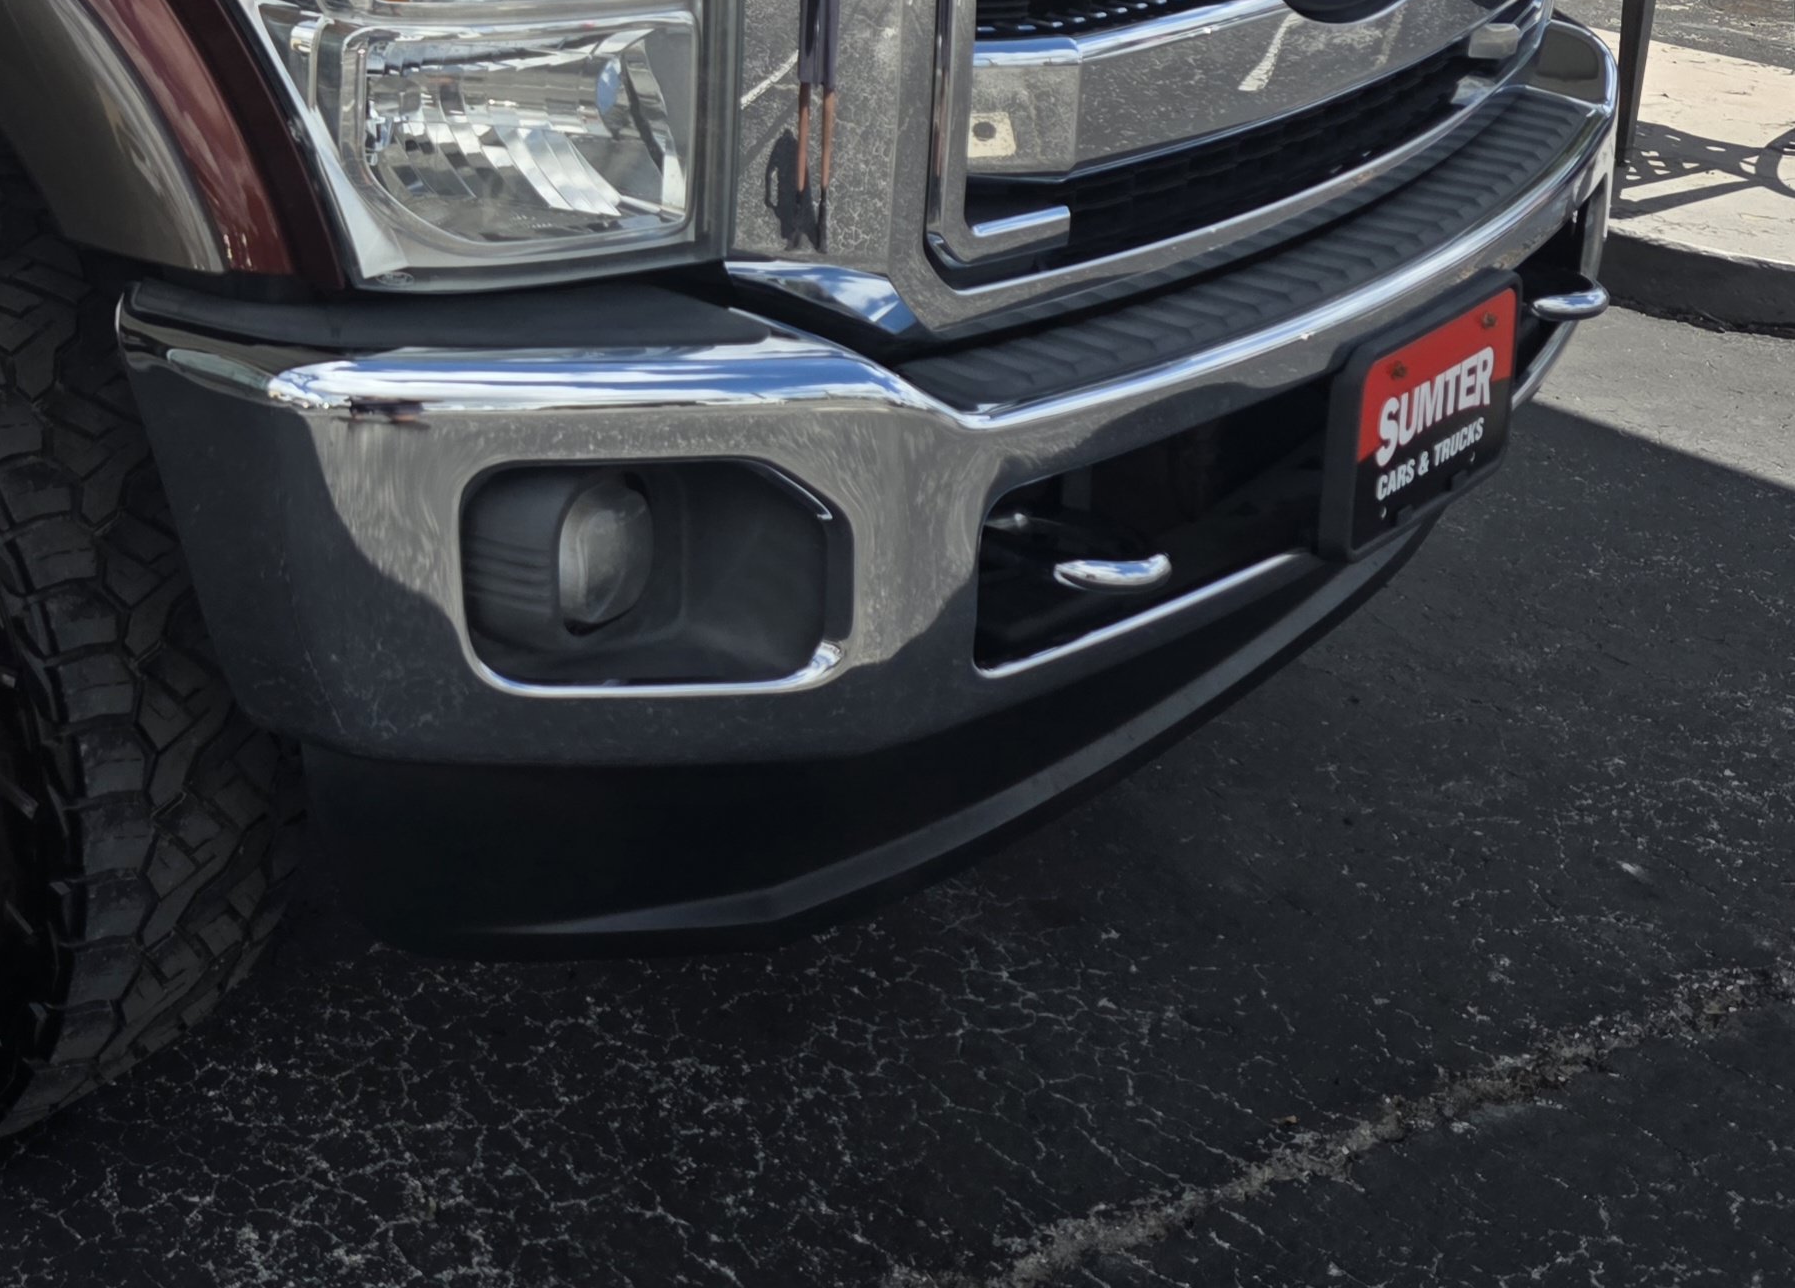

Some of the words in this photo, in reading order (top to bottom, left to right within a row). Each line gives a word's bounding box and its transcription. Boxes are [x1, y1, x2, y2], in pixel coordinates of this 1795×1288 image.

[1375, 345, 1495, 468] SUMTER
[1375, 459, 1416, 502] CARS
[1416, 450, 1430, 476] &
[1433, 416, 1485, 468] TRUCKS
